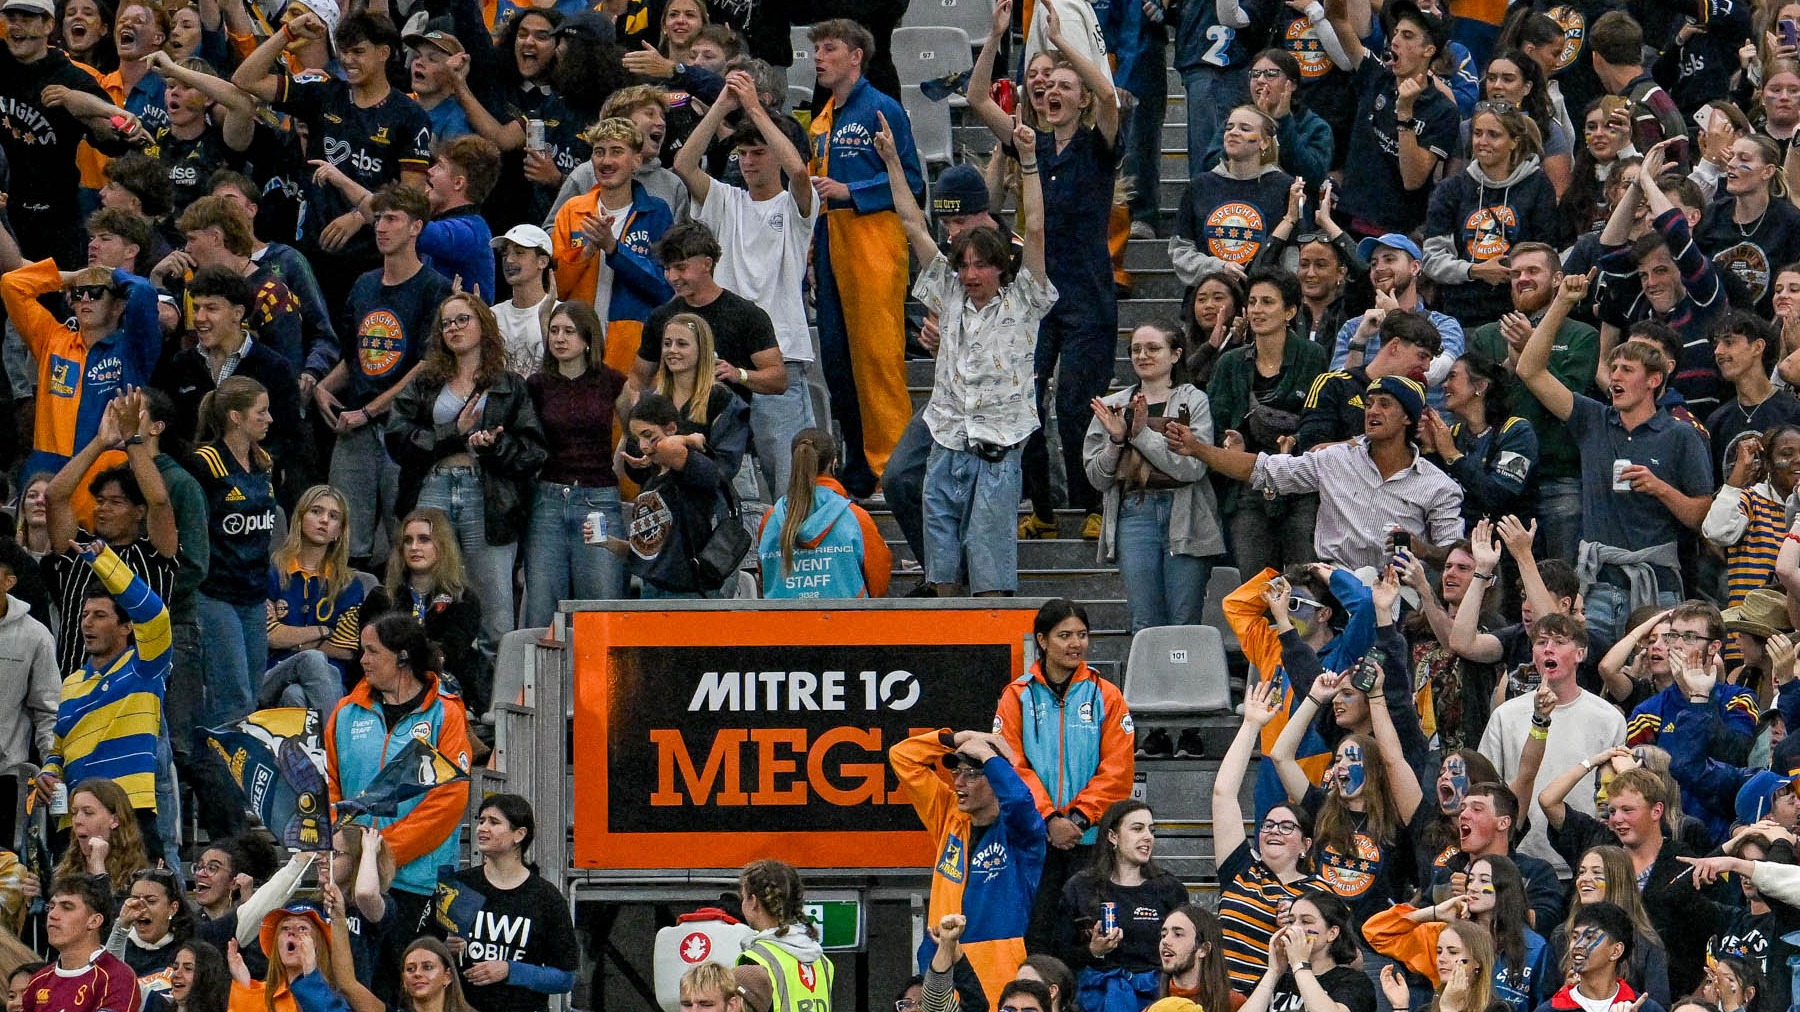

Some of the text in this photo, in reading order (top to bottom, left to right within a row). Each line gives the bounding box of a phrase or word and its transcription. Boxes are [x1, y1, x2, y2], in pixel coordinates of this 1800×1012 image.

[1205, 25, 1234, 66] 2
[0, 96, 57, 147] IGHT'S
[832, 123, 874, 147] SPEIGHT'S
[1210, 206, 1260, 230] SPEIGHT'S
[790, 557, 831, 571] VENT
[785, 573, 831, 588] STAFF
[1172, 652, 1186, 660] 101
[688, 670, 921, 711] MITRE 10
[469, 910, 532, 948] IWI
